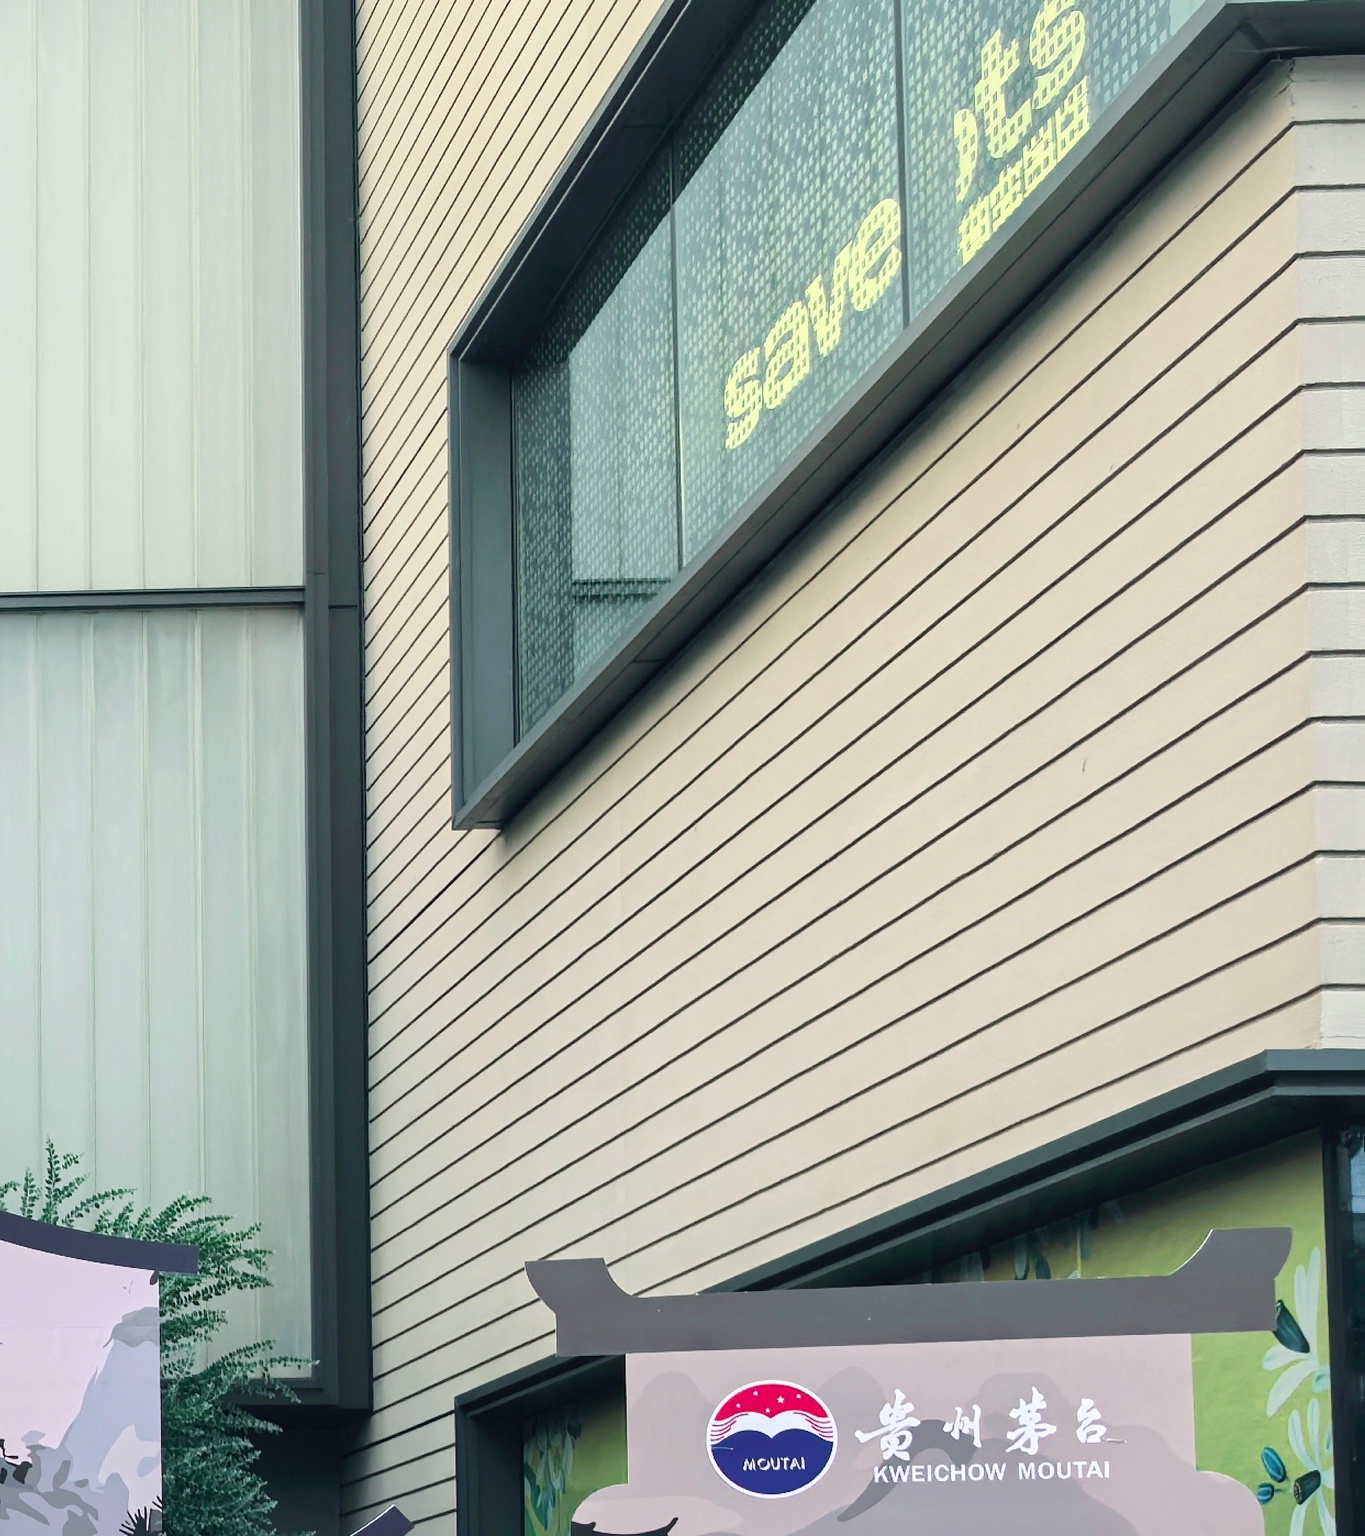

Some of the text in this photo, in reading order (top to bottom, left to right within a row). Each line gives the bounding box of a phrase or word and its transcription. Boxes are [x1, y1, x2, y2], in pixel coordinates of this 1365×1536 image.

[724, 198, 903, 449] save
[742, 1456, 806, 1473] MOUTAI
[872, 1460, 1111, 1484] KWEICHOW MOUTAI
